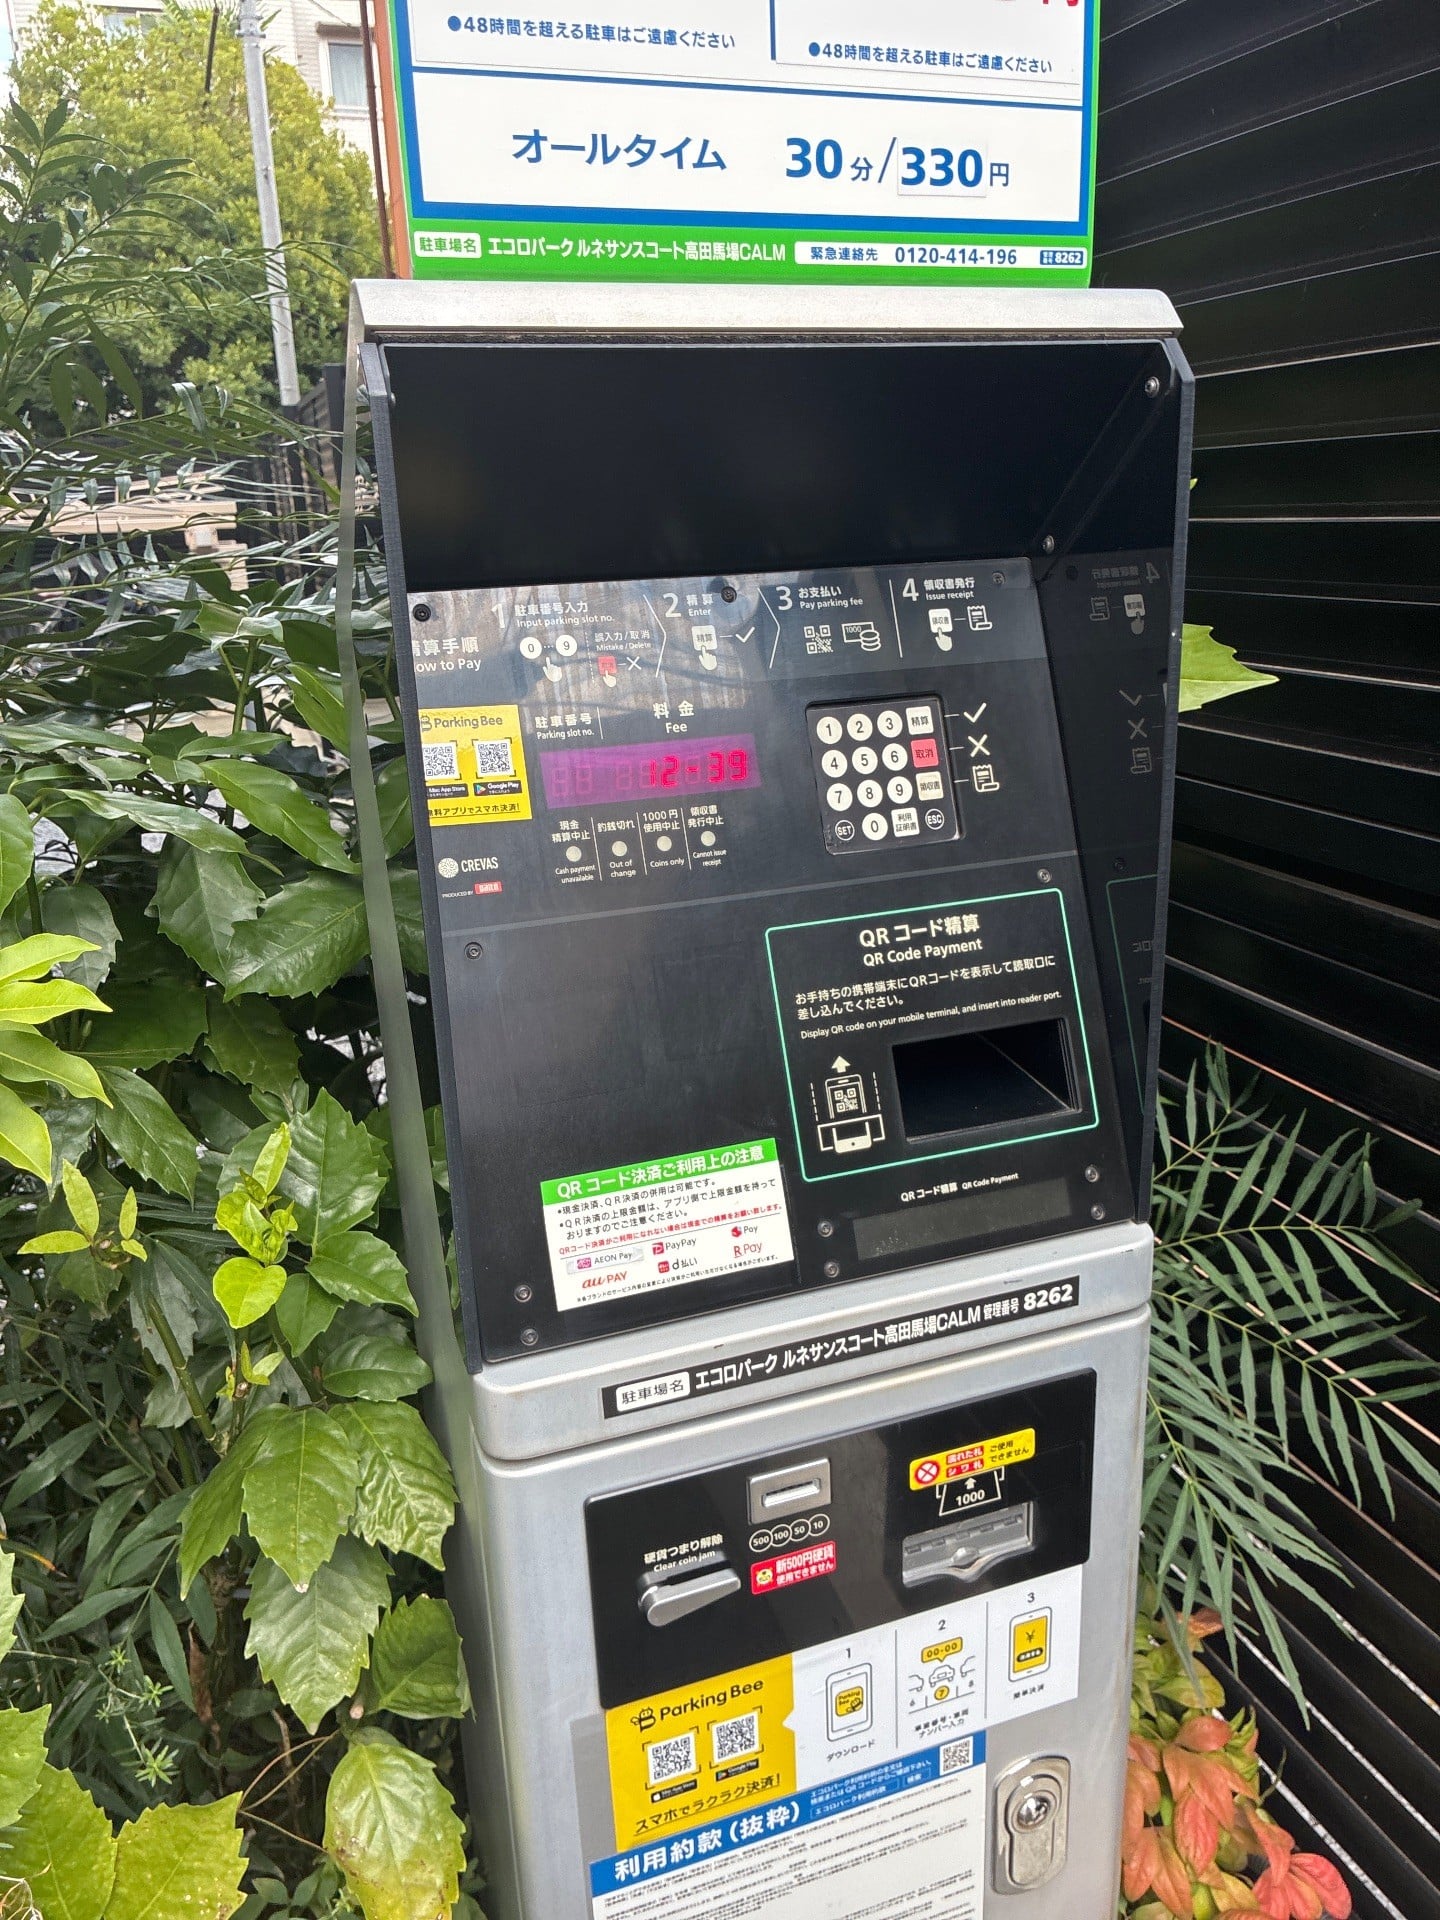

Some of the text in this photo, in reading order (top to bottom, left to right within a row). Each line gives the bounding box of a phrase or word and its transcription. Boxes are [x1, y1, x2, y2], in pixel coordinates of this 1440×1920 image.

[512, 128, 727, 171] オールタイム
[419, 236, 786, 262] 駐車場名 エコロパーク ルネサンスコート高田馬場CALM
[810, 246, 1017, 265] 緊急連絡先 0120-414-196
[1055, 251, 1082, 264] 8262
[903, 578, 976, 601] 4 領収書発行
[925, 590, 974, 600] Issue receipt
[663, 592, 682, 618] 2
[776, 585, 842, 611] 3 お支払い
[800, 597, 863, 611] Pay parking fee
[491, 602, 589, 629] 1 駐車番号入力
[688, 607, 711, 617] Enter
[516, 618, 542, 628] Input
[544, 616, 580, 628] parking
[581, 615, 596, 624] slot
[440, 658, 481, 671] to Pay
[653, 701, 694, 718] 料金
[434, 715, 503, 729] Parking Bee
[535, 713, 592, 728] 駐車番号
[666, 722, 687, 733] Fee
[825, 715, 929, 737] 1 2 3 精算
[537, 728, 594, 740] Parking slot no.
[830, 748, 934, 770] 4 5 6 取消
[834, 791, 843, 804] 7
[865, 787, 874, 800] 8
[895, 783, 904, 796] 9
[690, 805, 718, 816] 領収書
[559, 820, 579, 830] 現金
[597, 820, 635, 832] 釣銭切れ
[687, 816, 724, 829] 発行中止
[927, 814, 942, 825] ESC
[643, 821, 681, 833] 使用中止
[837, 820, 879, 837] SET 0
[552, 830, 591, 843] 精算中止
[693, 849, 727, 859] Cannot issue
[461, 857, 499, 873] CREVAS
[555, 864, 595, 875] Cash payment
[609, 861, 622, 869] Out
[650, 858, 685, 868] Coins only
[702, 859, 722, 867] receipt
[561, 874, 594, 883] unavailable
[610, 868, 637, 878] change
[859, 927, 890, 948] QR
[863, 938, 983, 968] QR Code Payment
[800, 991, 1062, 1040] Display QR code on your mobile terminal, and insert into reader port.
[557, 1180, 582, 1199] QR
[901, 1191, 915, 1202] QR
[961, 1182, 972, 1190] QR
[973, 1178, 990, 1187] Code
[990, 1173, 1019, 1184] Payment
[743, 1225, 758, 1235] Pay
[665, 1238, 697, 1251] PayPay
[743, 1242, 763, 1254] Pay
[594, 1254, 618, 1264] AEON
[619, 1251, 633, 1260] Pay
[672, 1257, 698, 1270] d払い
[582, 1272, 627, 1289] au PAY
[621, 1283, 1073, 1405] 駐車場名 エコロパーク ルネサンスコート高田馬場CALM 管理番号 8262
[955, 1489, 985, 1506] 1000
[753, 1520, 824, 1546] 500 100 50 10
[643, 1533, 724, 1564] 硬貨つまり解除
[653, 1550, 716, 1573] Clear coin jam
[776, 1544, 834, 1573] 新500円硬貨
[1027, 1592, 1036, 1603] 3
[937, 1620, 947, 1631] 2
[845, 1648, 851, 1659] 1
[659, 1679, 764, 1721] Parking Bee
[826, 1739, 875, 1762] ダウンロード
